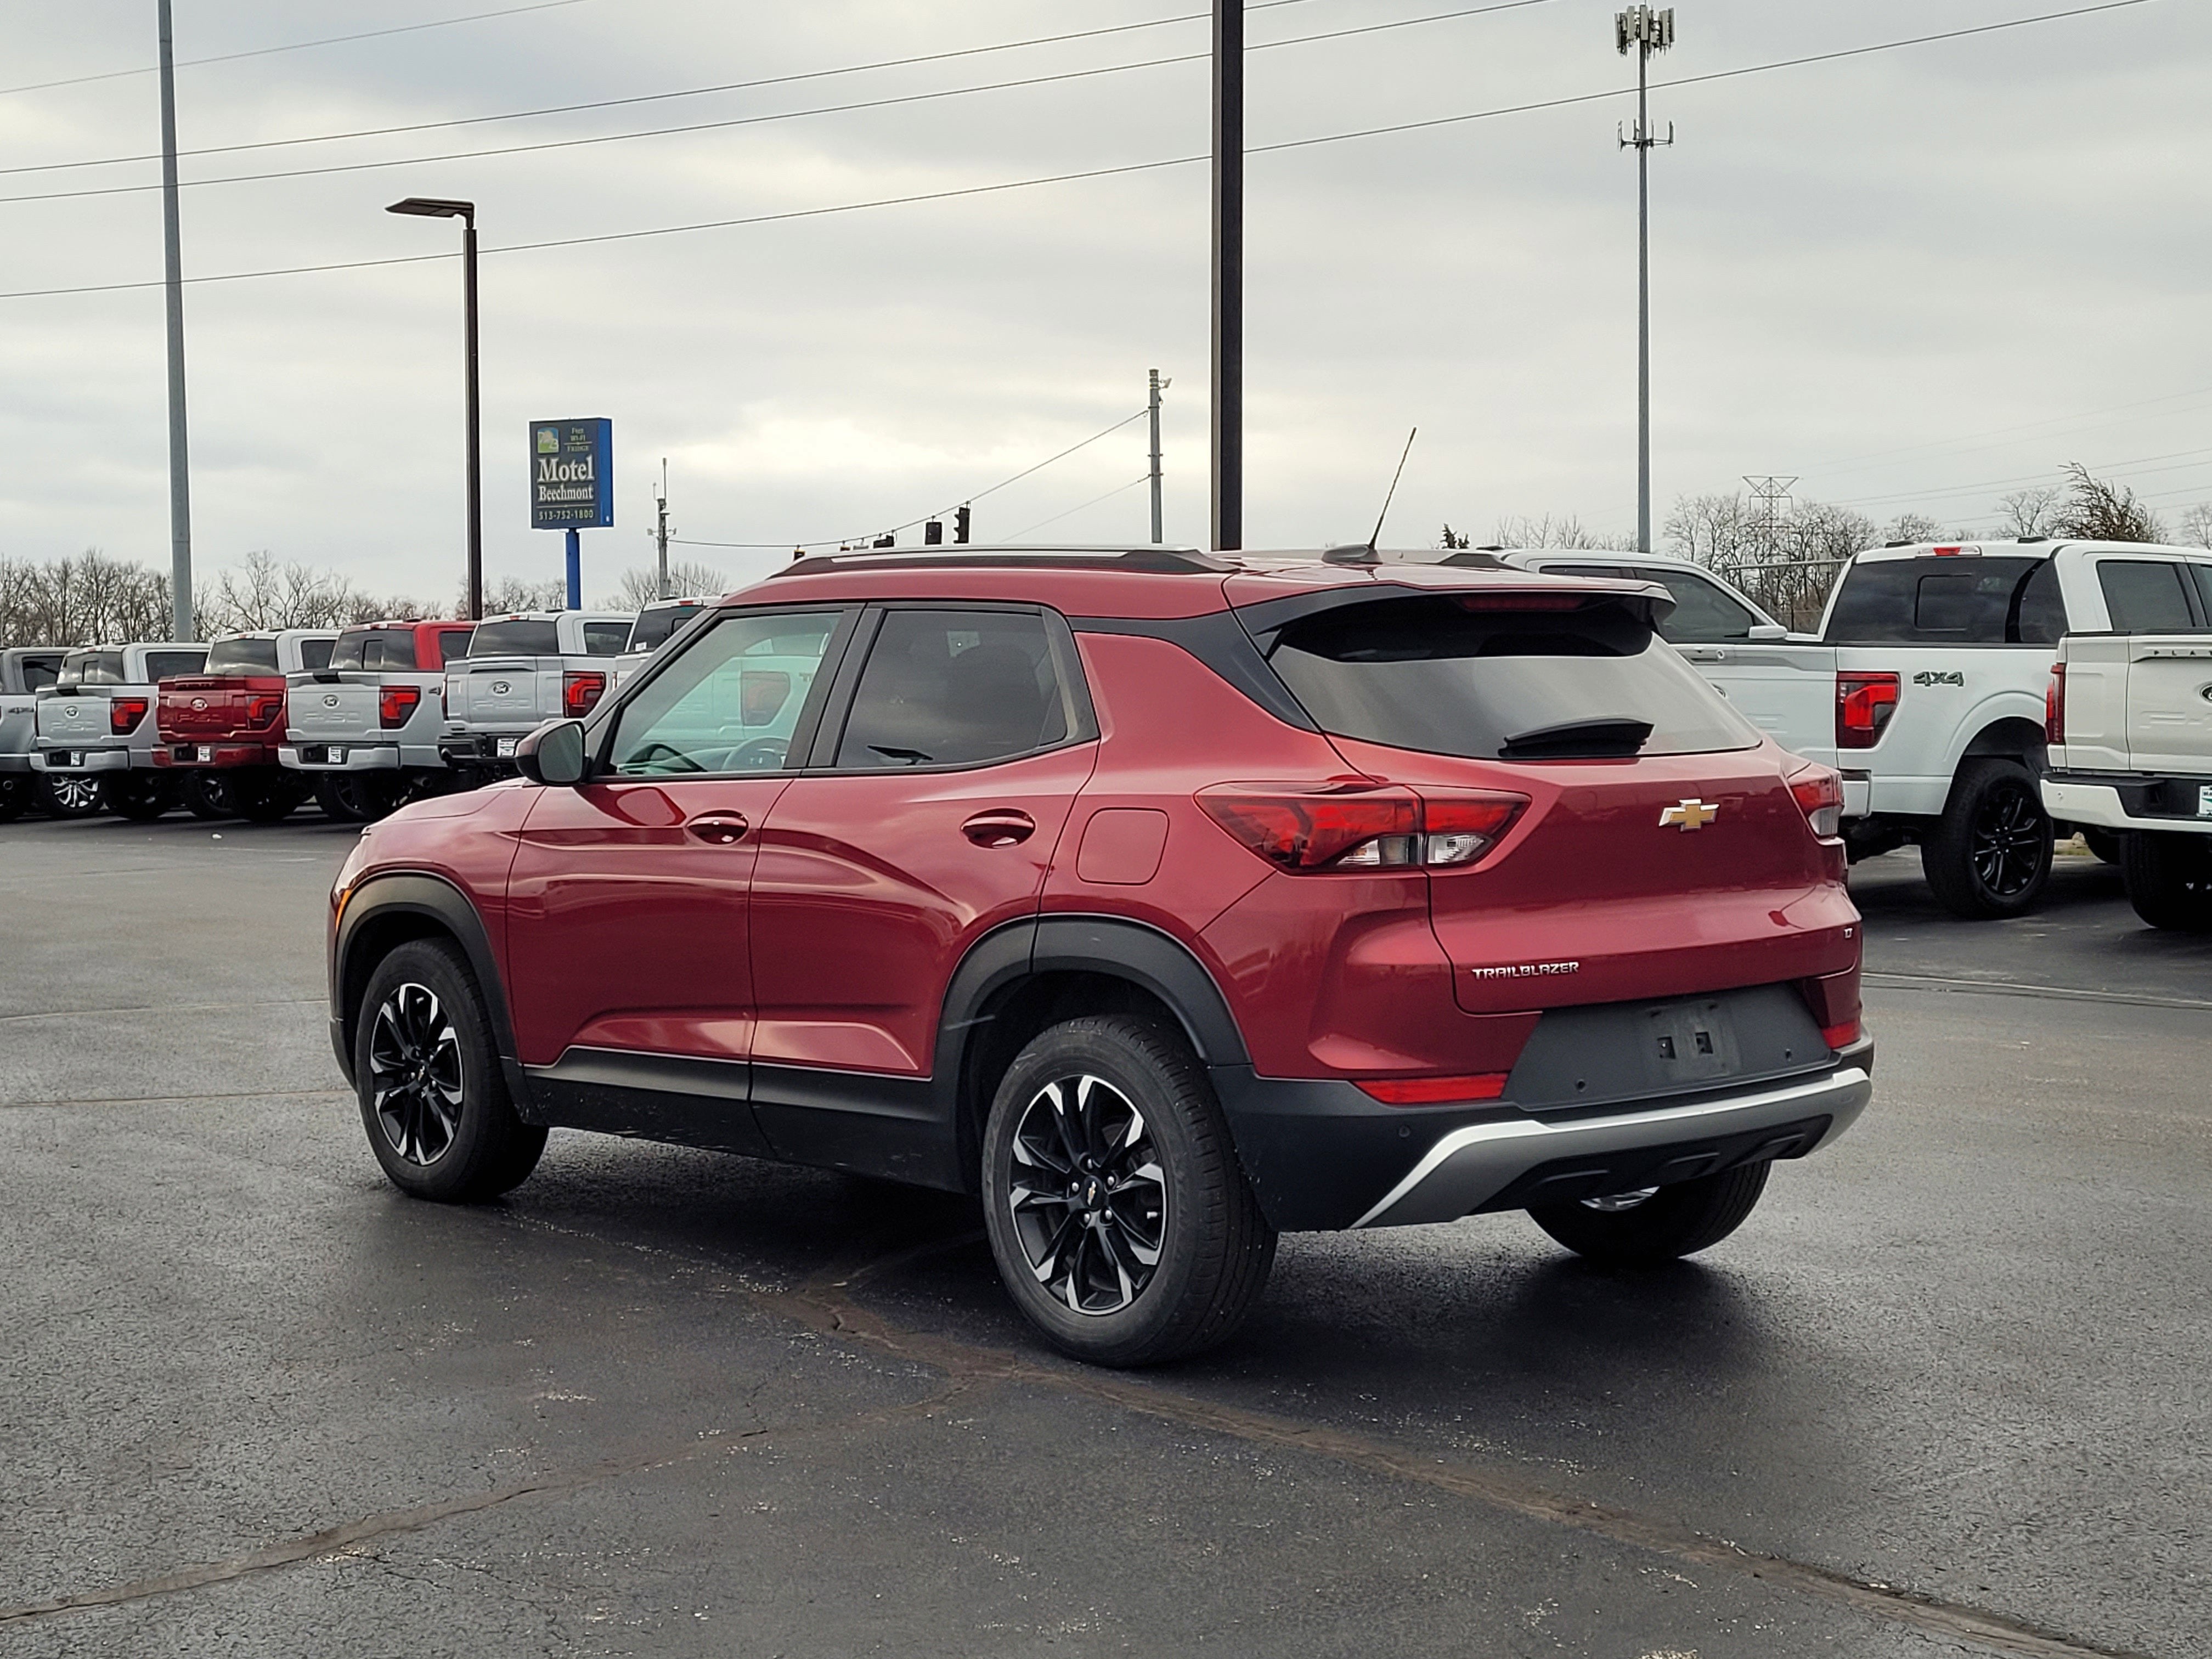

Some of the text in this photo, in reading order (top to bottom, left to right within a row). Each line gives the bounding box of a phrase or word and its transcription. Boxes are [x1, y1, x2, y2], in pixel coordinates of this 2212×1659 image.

[537, 454, 595, 482] Motel
[538, 483, 594, 501] Beechmont
[539, 509, 593, 520] 513-752-1800
[1471, 961, 1579, 980] TRAILBLAZER
